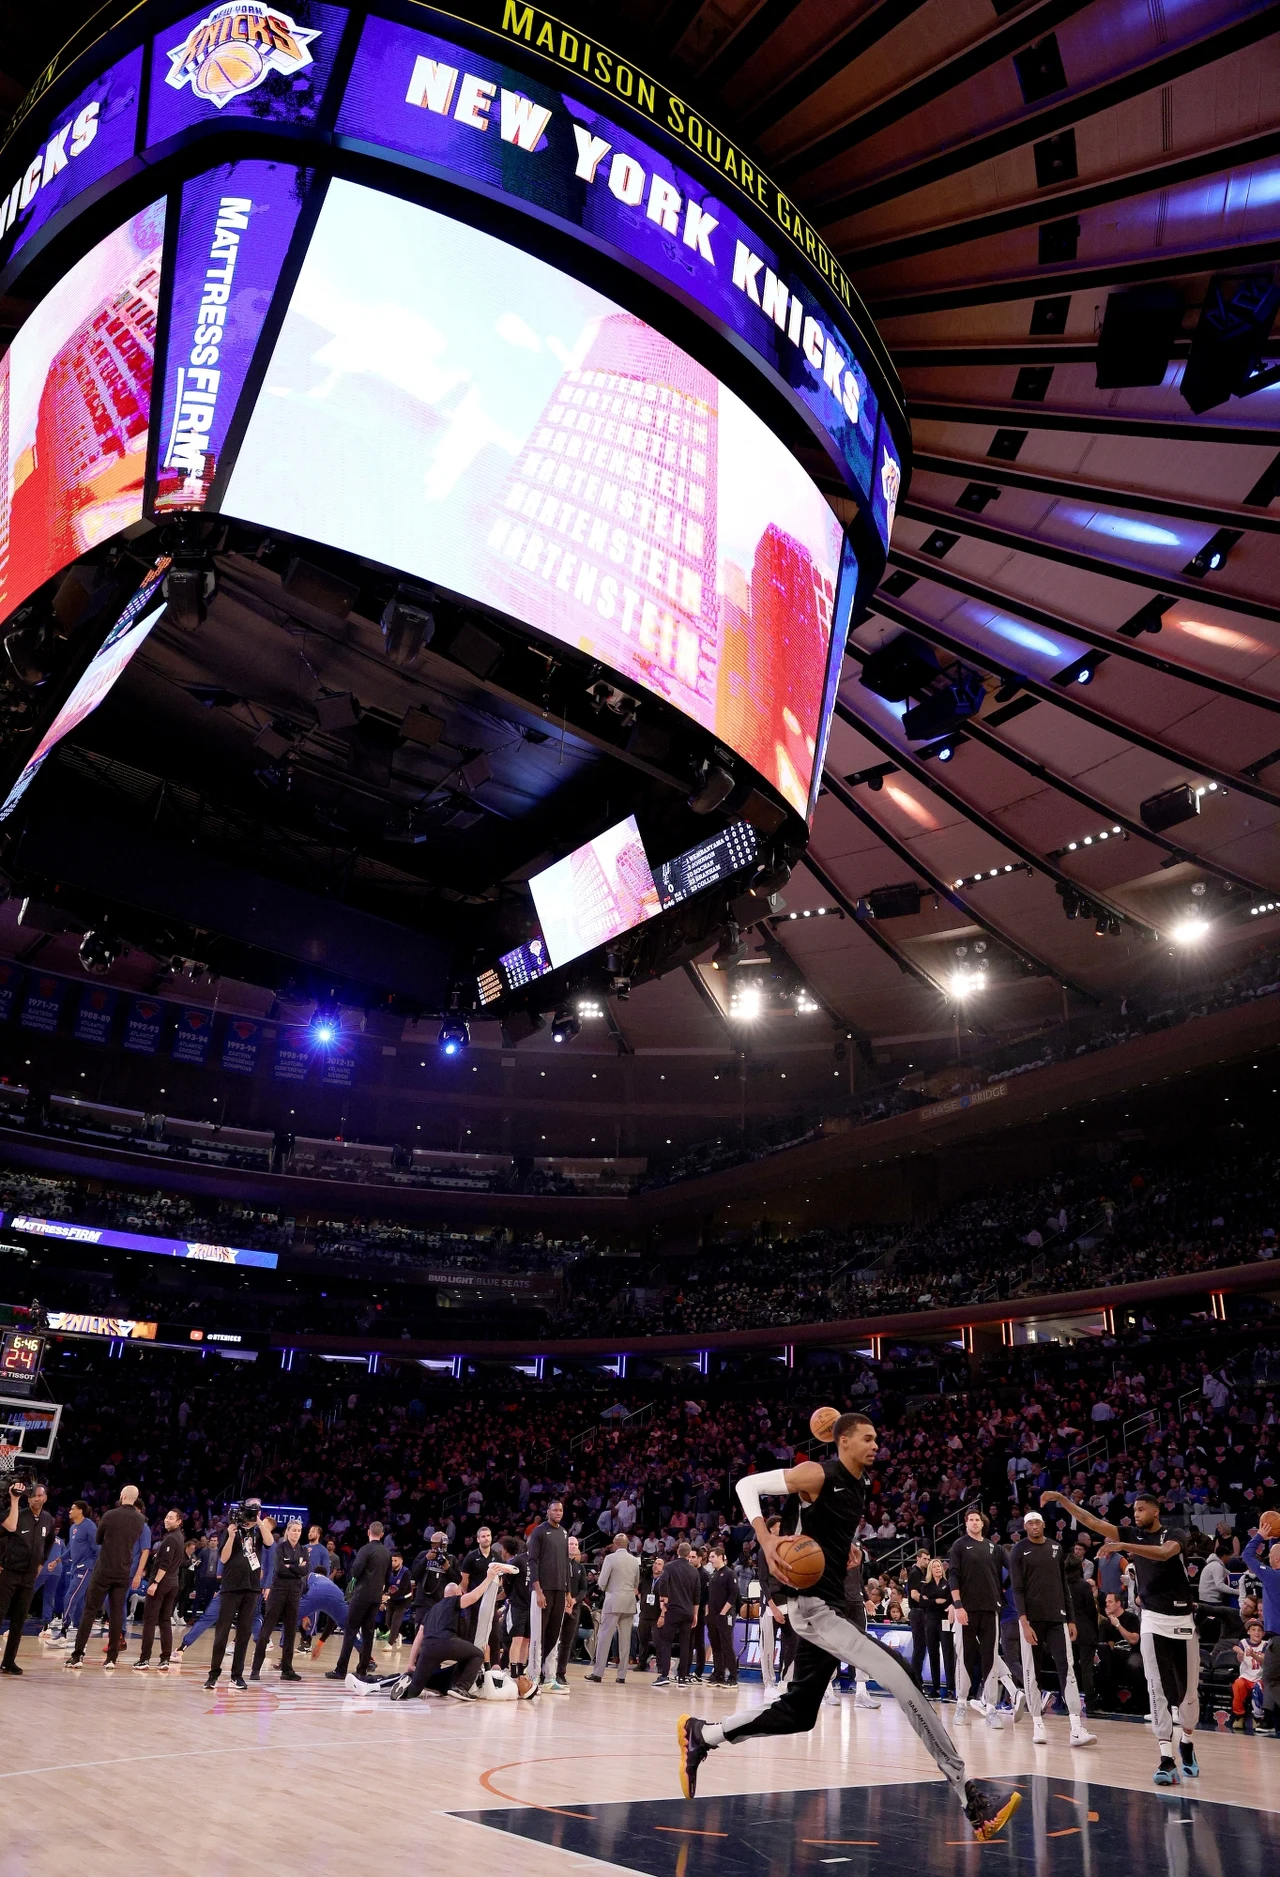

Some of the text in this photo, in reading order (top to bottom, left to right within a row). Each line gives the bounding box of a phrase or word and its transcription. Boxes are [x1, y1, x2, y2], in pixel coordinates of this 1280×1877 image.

[211, 5, 263, 22] NEW YORK
[175, 15, 303, 76] KNICKS
[502, 0, 852, 308] MADISON SQUARE GARDEN
[405, 55, 861, 424] NEW YORK KNICKS
[668, 884, 674, 892] 0
[921, 1085, 1006, 1119] CHASE BRIDGE
[428, 1274, 530, 1289] BUD LIGHT BLUE SEATS
[59, 1313, 122, 1337] KNICKS
[13, 1335, 39, 1350] 6:46
[5, 1348, 33, 1369] 24
[7, 1371, 35, 1380] TISSOT
[917, 1714, 936, 1740] ANTONIO
